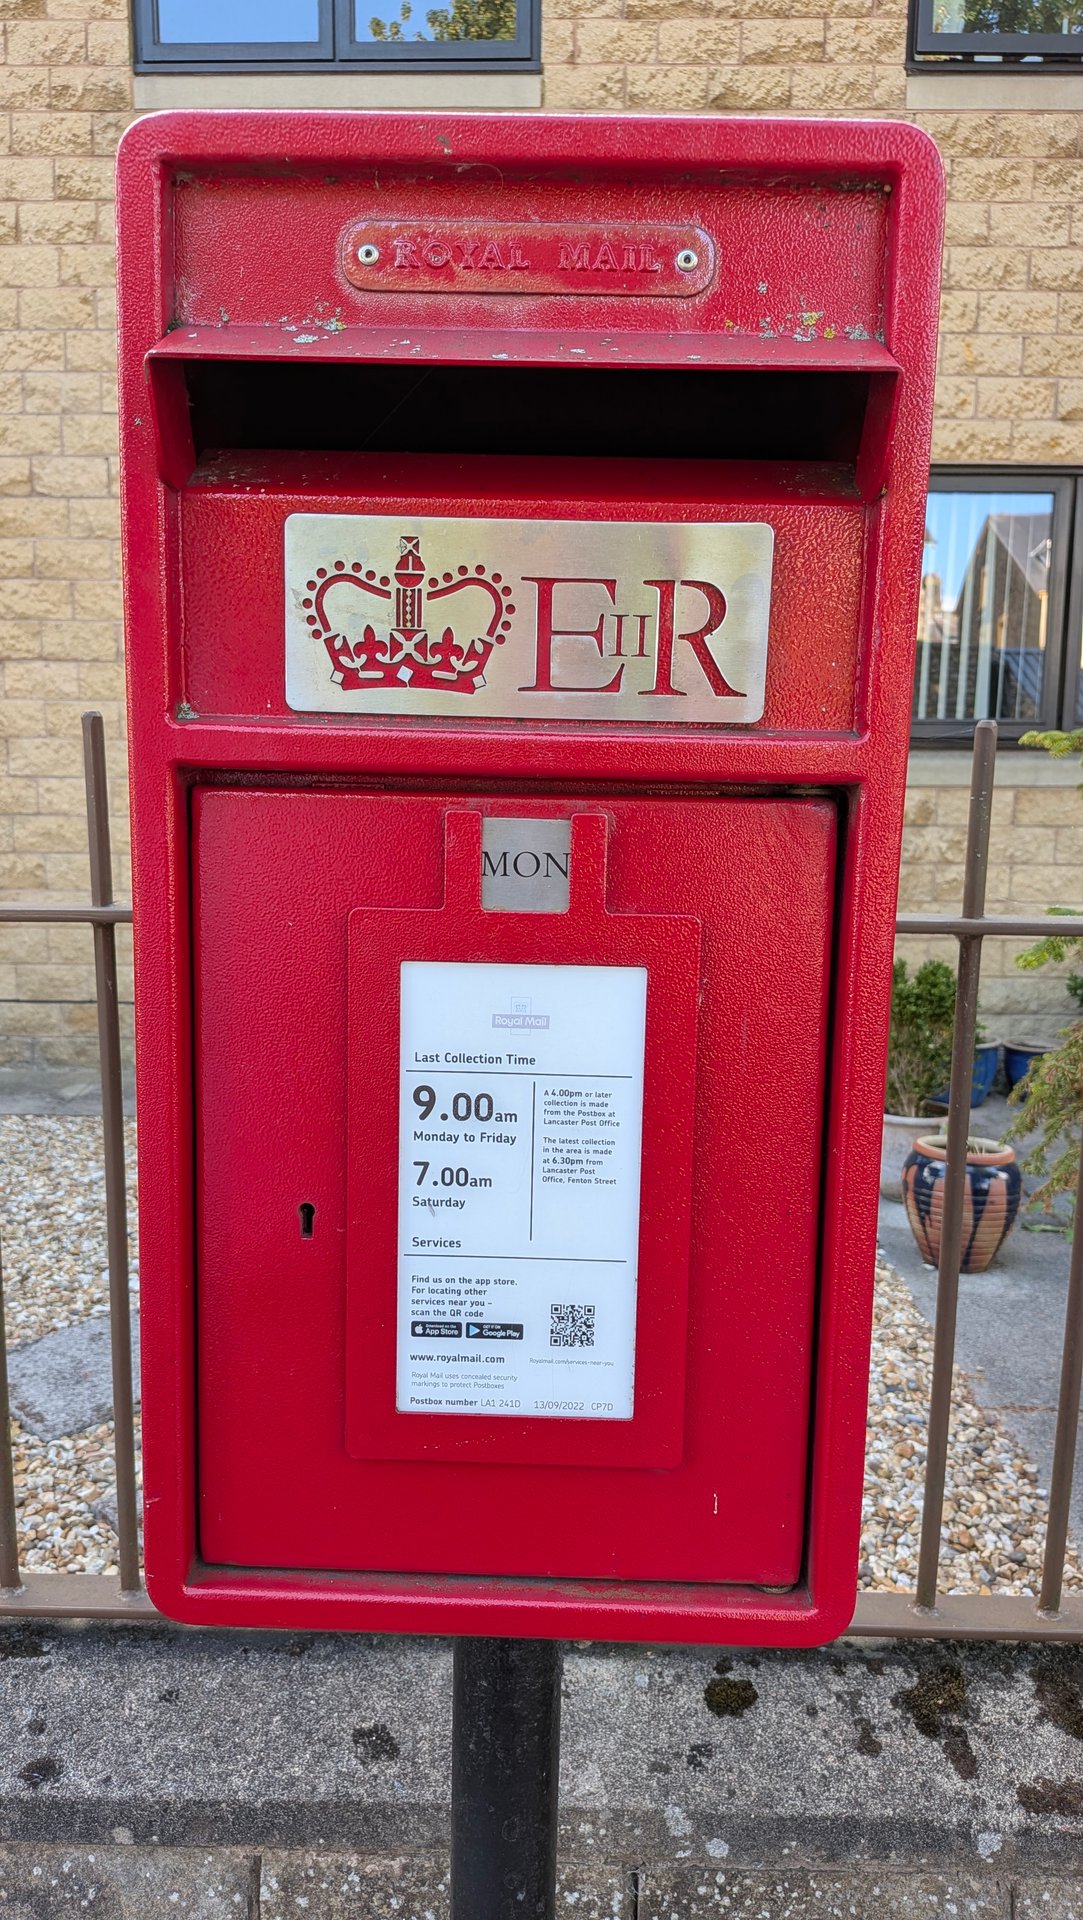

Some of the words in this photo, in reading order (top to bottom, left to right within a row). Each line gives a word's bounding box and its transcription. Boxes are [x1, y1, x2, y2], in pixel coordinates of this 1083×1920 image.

[393, 239, 529, 271] ROYAL
[559, 243, 661, 273] MAIL
[482, 851, 570, 879] MON
[495, 1016, 523, 1027] Royal
[525, 1017, 547, 1026] Mail
[414, 1052, 440, 1063] Last
[444, 1053, 502, 1064] Collection
[506, 1054, 536, 1065] Time
[551, 1090, 583, 1099] 4.00pm
[544, 1099, 578, 1107] collection
[589, 1100, 609, 1108] made
[543, 1118, 579, 1127] Lancaster
[581, 1119, 597, 1127] Post
[413, 1131, 459, 1144] Monday
[464, 1132, 475, 1142] to
[480, 1132, 517, 1145] Friday
[582, 1138, 615, 1146] collection
[552, 1157, 583, 1166] 6.30pm
[542, 1176, 566, 1184] Office,
[412, 1197, 466, 1209] Saturday
[412, 1237, 462, 1248] Services
[412, 1275, 430, 1284] Find
[459, 1277, 472, 1285] the
[475, 1278, 491, 1287] app
[494, 1278, 518, 1286] store.
[412, 1287, 425, 1295] For
[428, 1287, 462, 1297] locating
[464, 1288, 488, 1296] other
[411, 1298, 445, 1306] services
[470, 1300, 485, 1308] you
[411, 1309, 431, 1317] scan
[433, 1309, 447, 1317] the
[449, 1309, 462, 1317] QR
[465, 1309, 483, 1318] code
[483, 1329, 506, 1338] Google
[507, 1330, 520, 1338] Play
[410, 1353, 505, 1364] www.royalmail.com
[412, 1371, 428, 1380] Royal
[461, 1372, 491, 1380] concealed
[493, 1374, 518, 1382] security
[412, 1380, 440, 1389] markings
[450, 1381, 471, 1390] protect
[410, 1397, 442, 1406] Postbox
[445, 1398, 478, 1406] number
[481, 1398, 496, 1407] LA1
[499, 1399, 520, 1408] 241D
[534, 1400, 585, 1411] 13/09/2022
[591, 1402, 613, 1411] CP7D
